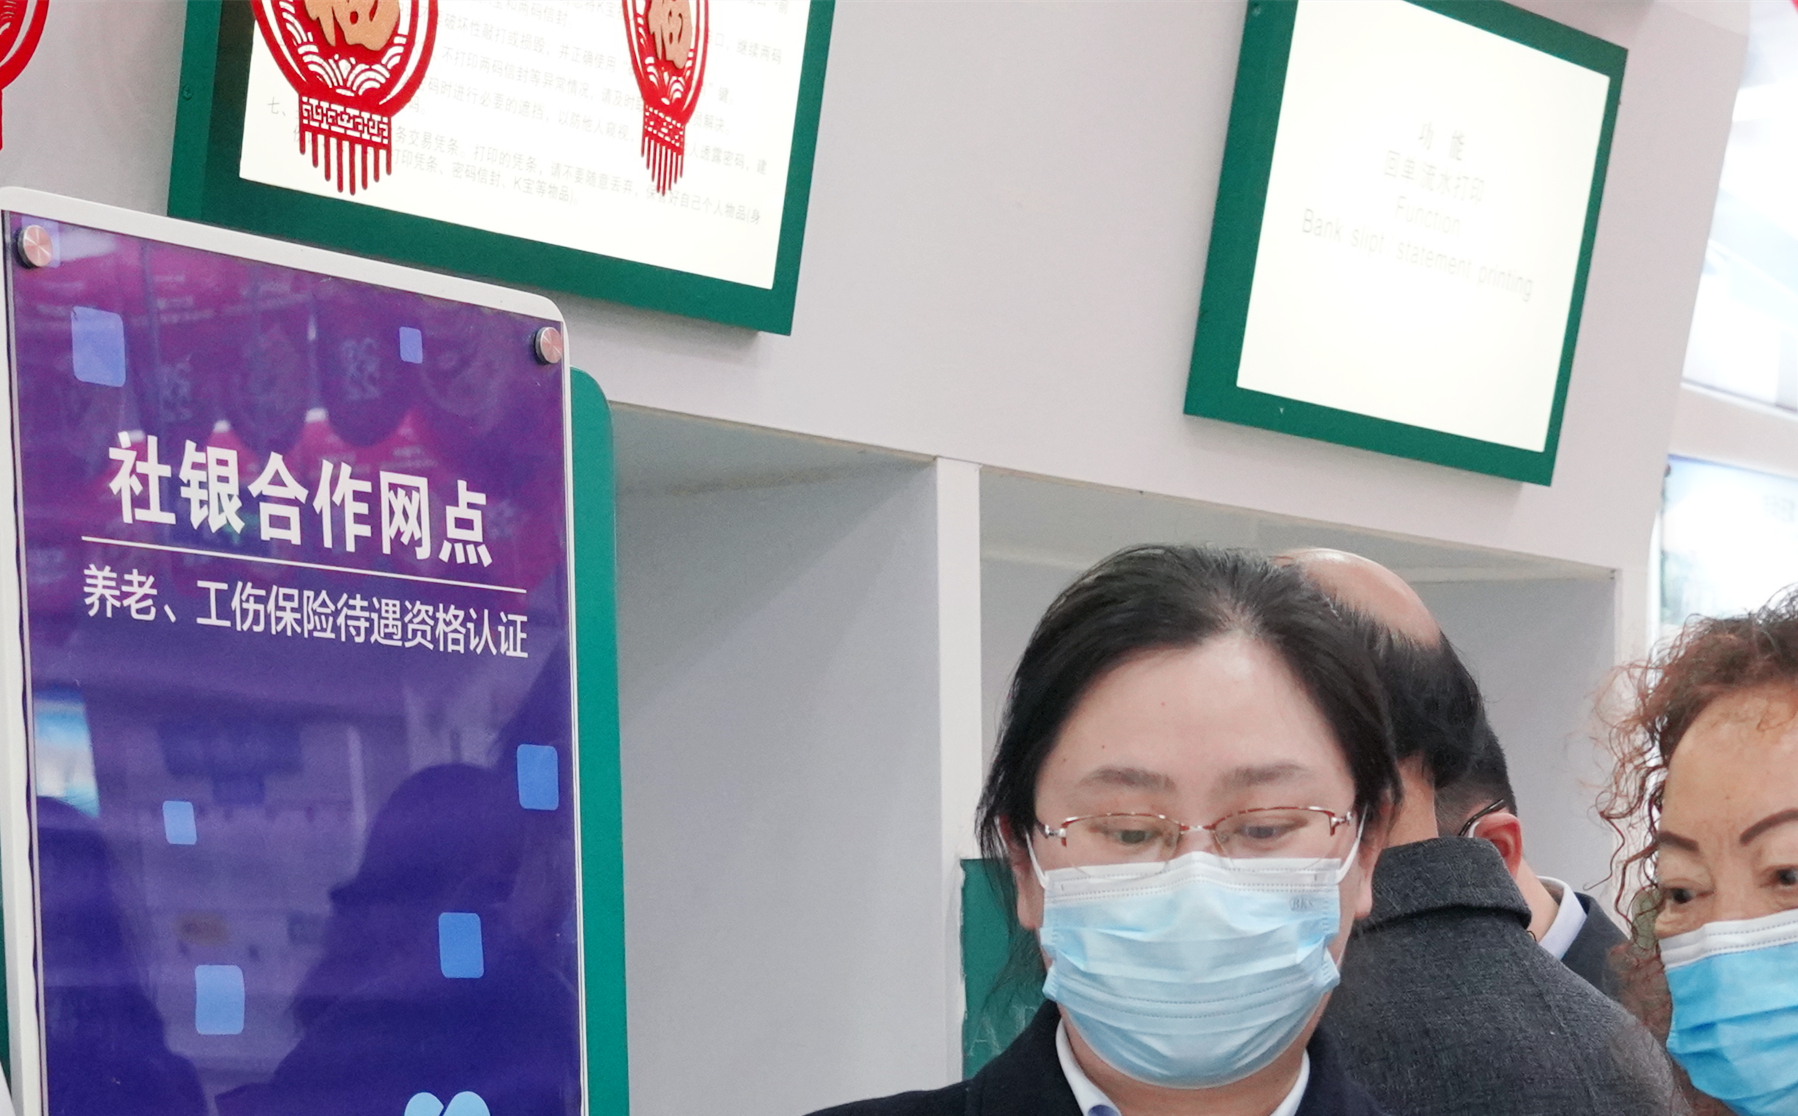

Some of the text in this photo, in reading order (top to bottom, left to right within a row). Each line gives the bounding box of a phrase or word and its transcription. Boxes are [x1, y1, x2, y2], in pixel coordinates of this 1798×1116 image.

[1301, 208, 1344, 243] Bank
[1396, 240, 1473, 281] statement
[1476, 263, 1535, 303] printing
[1395, 195, 1463, 237] Function
[108, 431, 493, 567] 社银合作网点
[83, 563, 529, 659] 养老、工伤保险待遇资格认证
